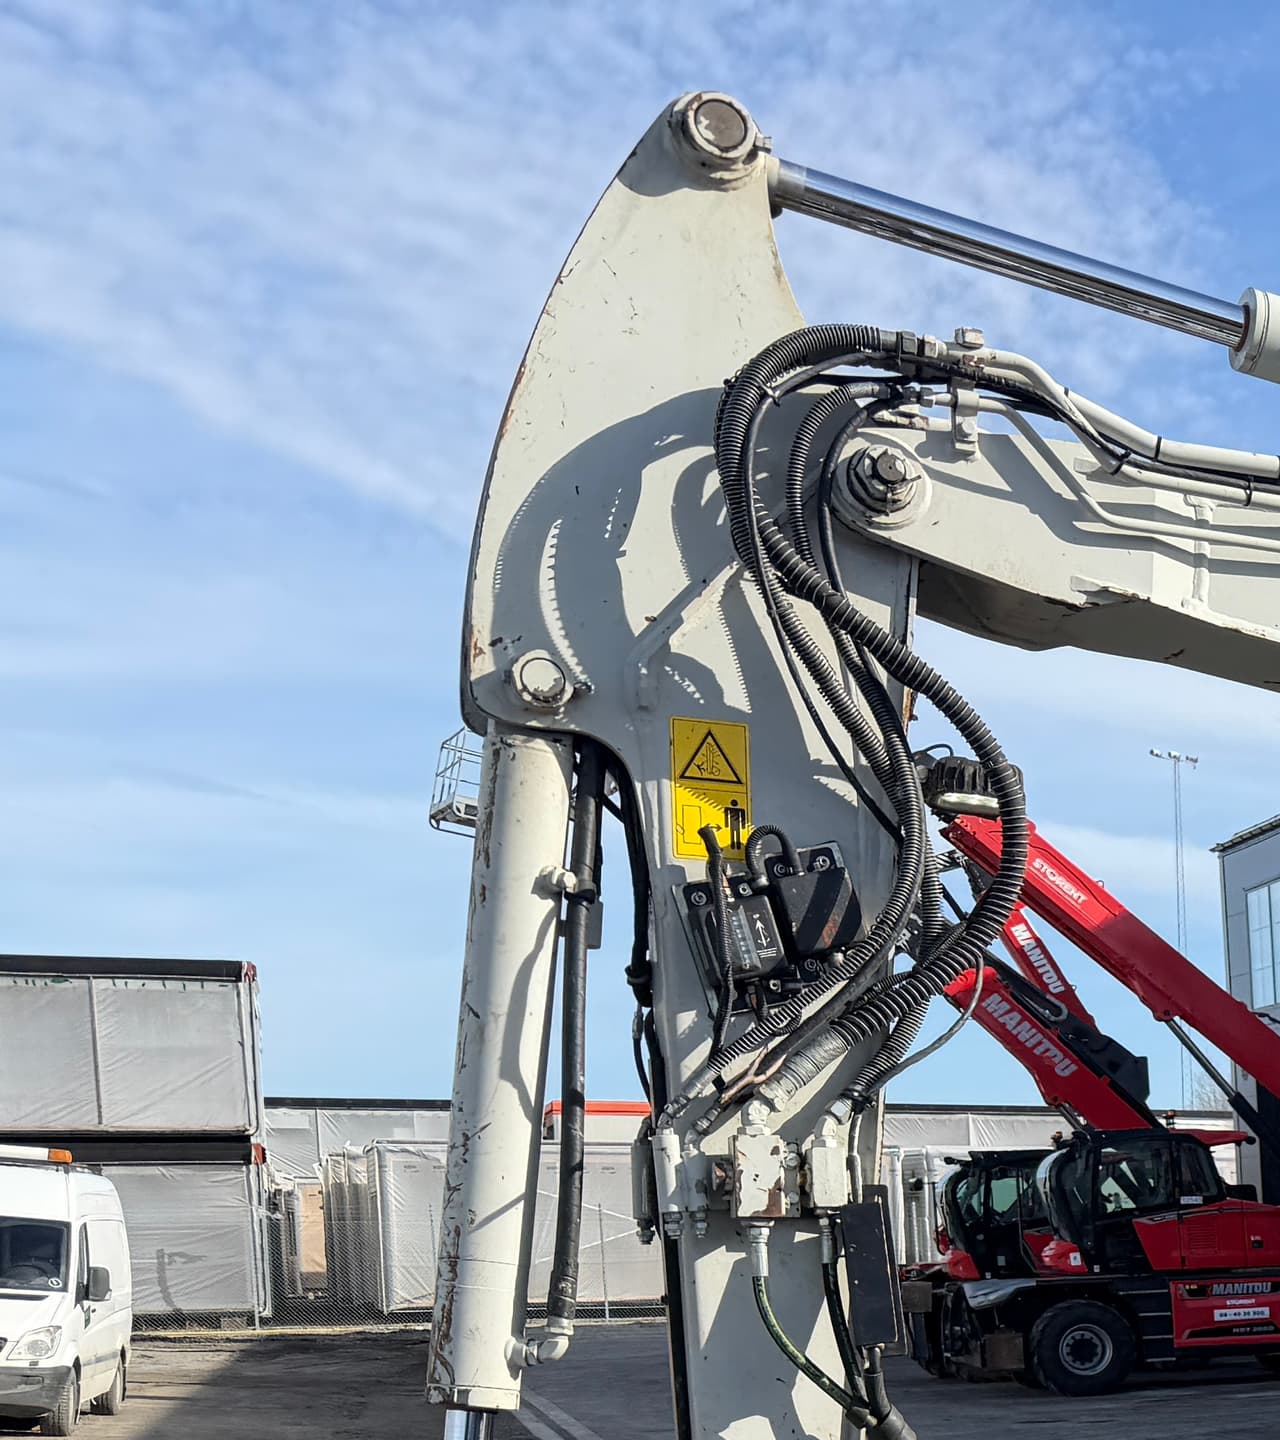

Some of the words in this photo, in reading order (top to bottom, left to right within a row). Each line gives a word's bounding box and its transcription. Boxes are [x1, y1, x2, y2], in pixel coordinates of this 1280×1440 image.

[1031, 857, 1088, 905] STORENT
[1010, 922, 1066, 995] MANITOU
[982, 992, 1079, 1078] MANITOU
[1212, 1281, 1272, 1296] MANITOU
